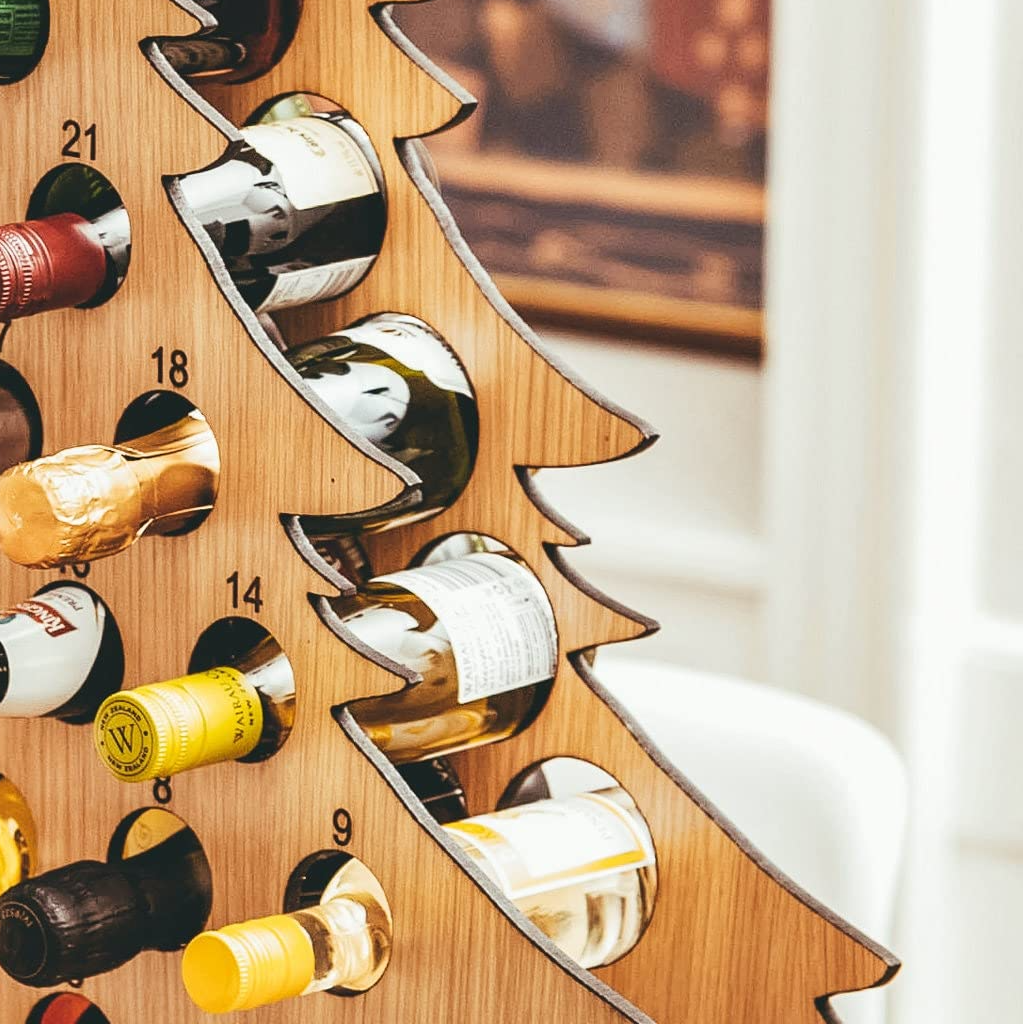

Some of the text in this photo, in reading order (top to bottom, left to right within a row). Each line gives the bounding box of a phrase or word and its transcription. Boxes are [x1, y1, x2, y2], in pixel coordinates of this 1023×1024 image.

[61, 119, 97, 161] 21
[151, 346, 188, 388] 18
[226, 570, 264, 613] 14
[99, 704, 142, 731] NEW ZEALAND
[107, 746, 149, 772] NEW ZEALAND
[108, 723, 135, 755] W
[333, 807, 353, 847] 9
